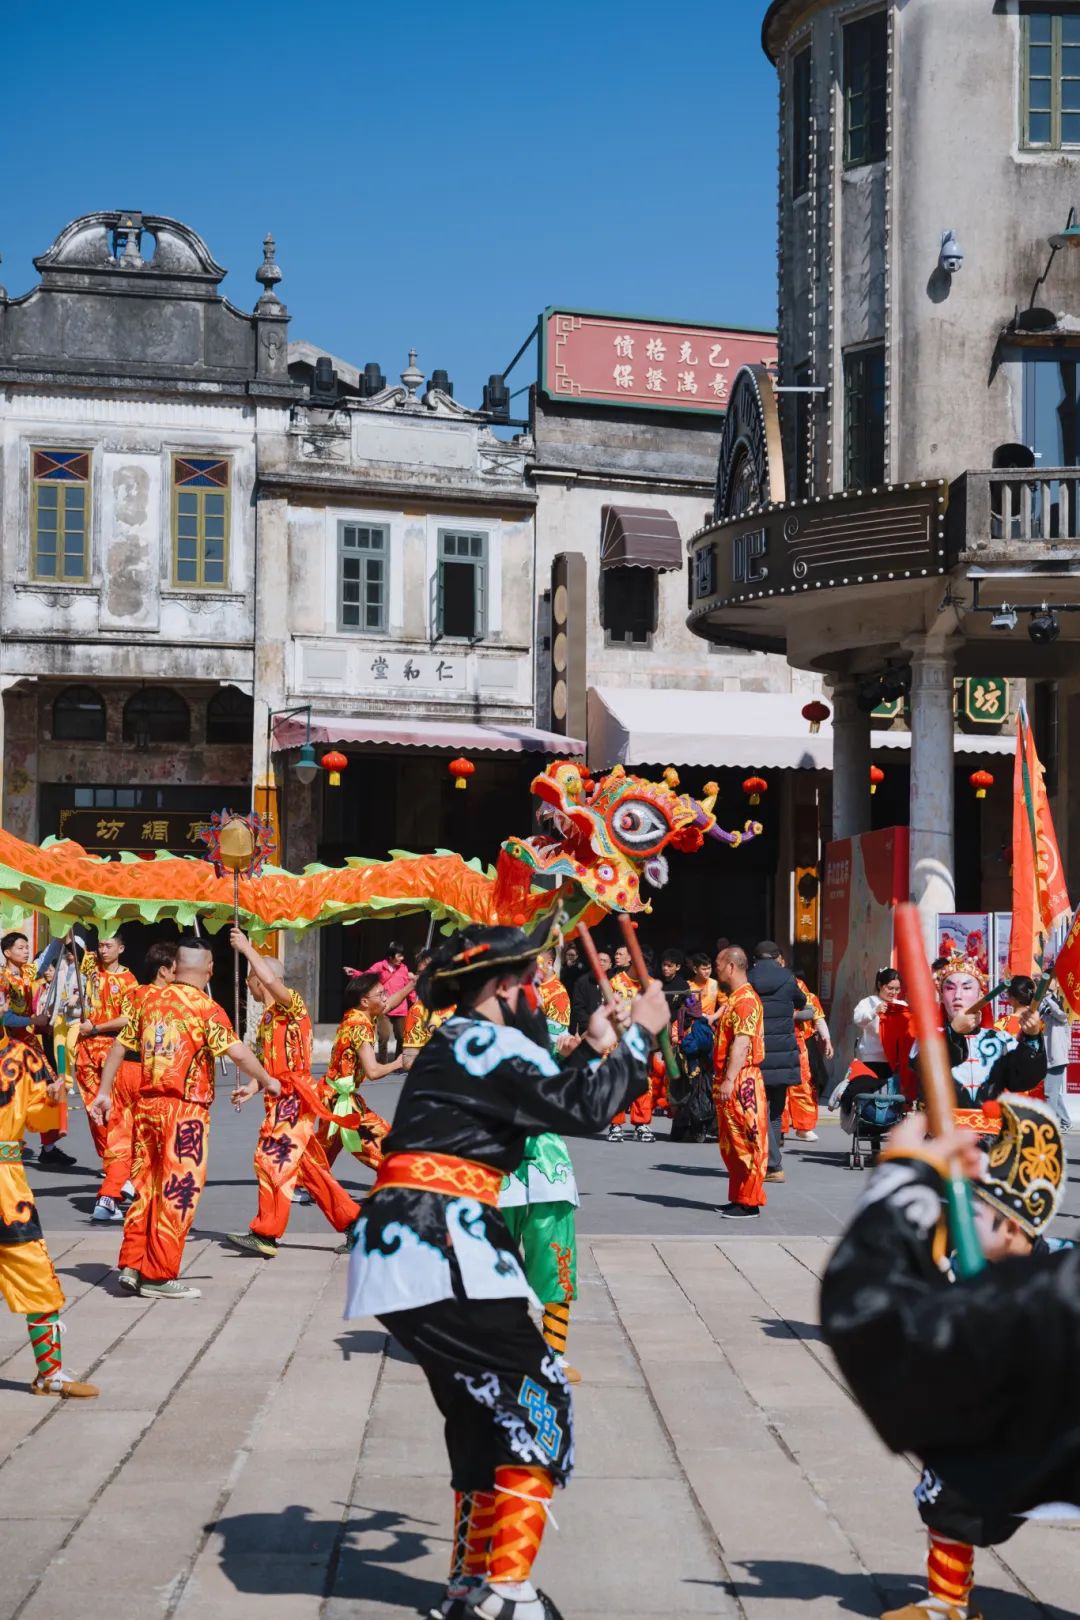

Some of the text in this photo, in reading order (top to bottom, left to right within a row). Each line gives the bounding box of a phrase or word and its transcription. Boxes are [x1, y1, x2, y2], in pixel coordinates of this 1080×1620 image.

[613, 335, 730, 368] 價格克己
[612, 364, 729, 398] 保證滿意
[973, 681, 1001, 714] 坊
